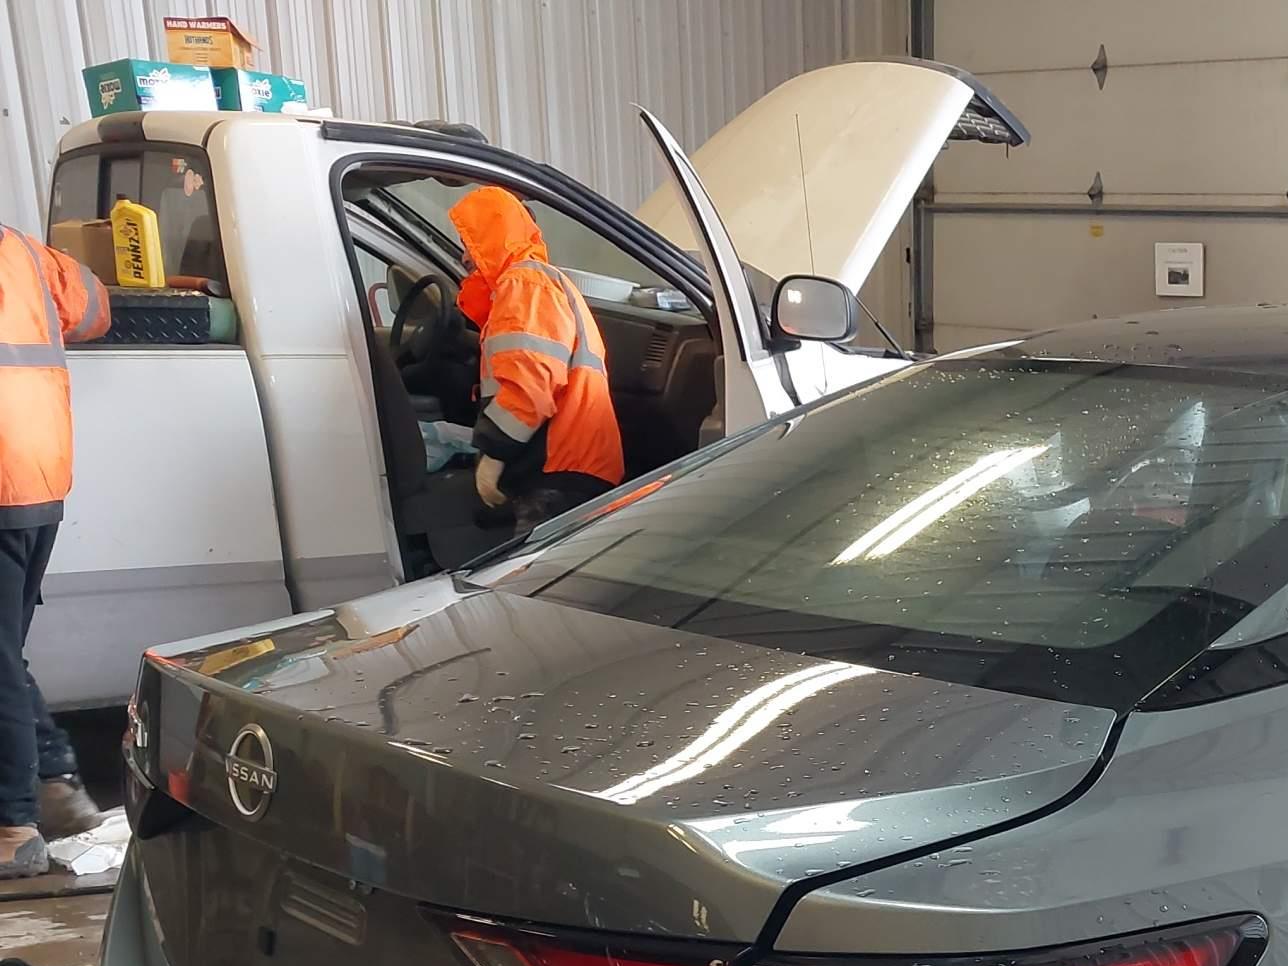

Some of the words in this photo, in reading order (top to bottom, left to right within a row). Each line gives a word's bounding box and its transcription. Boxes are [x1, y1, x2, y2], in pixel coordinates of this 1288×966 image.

[166, 20, 188, 28] HAND
[189, 21, 227, 30] WARMERS
[250, 87, 270, 97] oxie
[226, 759, 274, 790] SSAN
